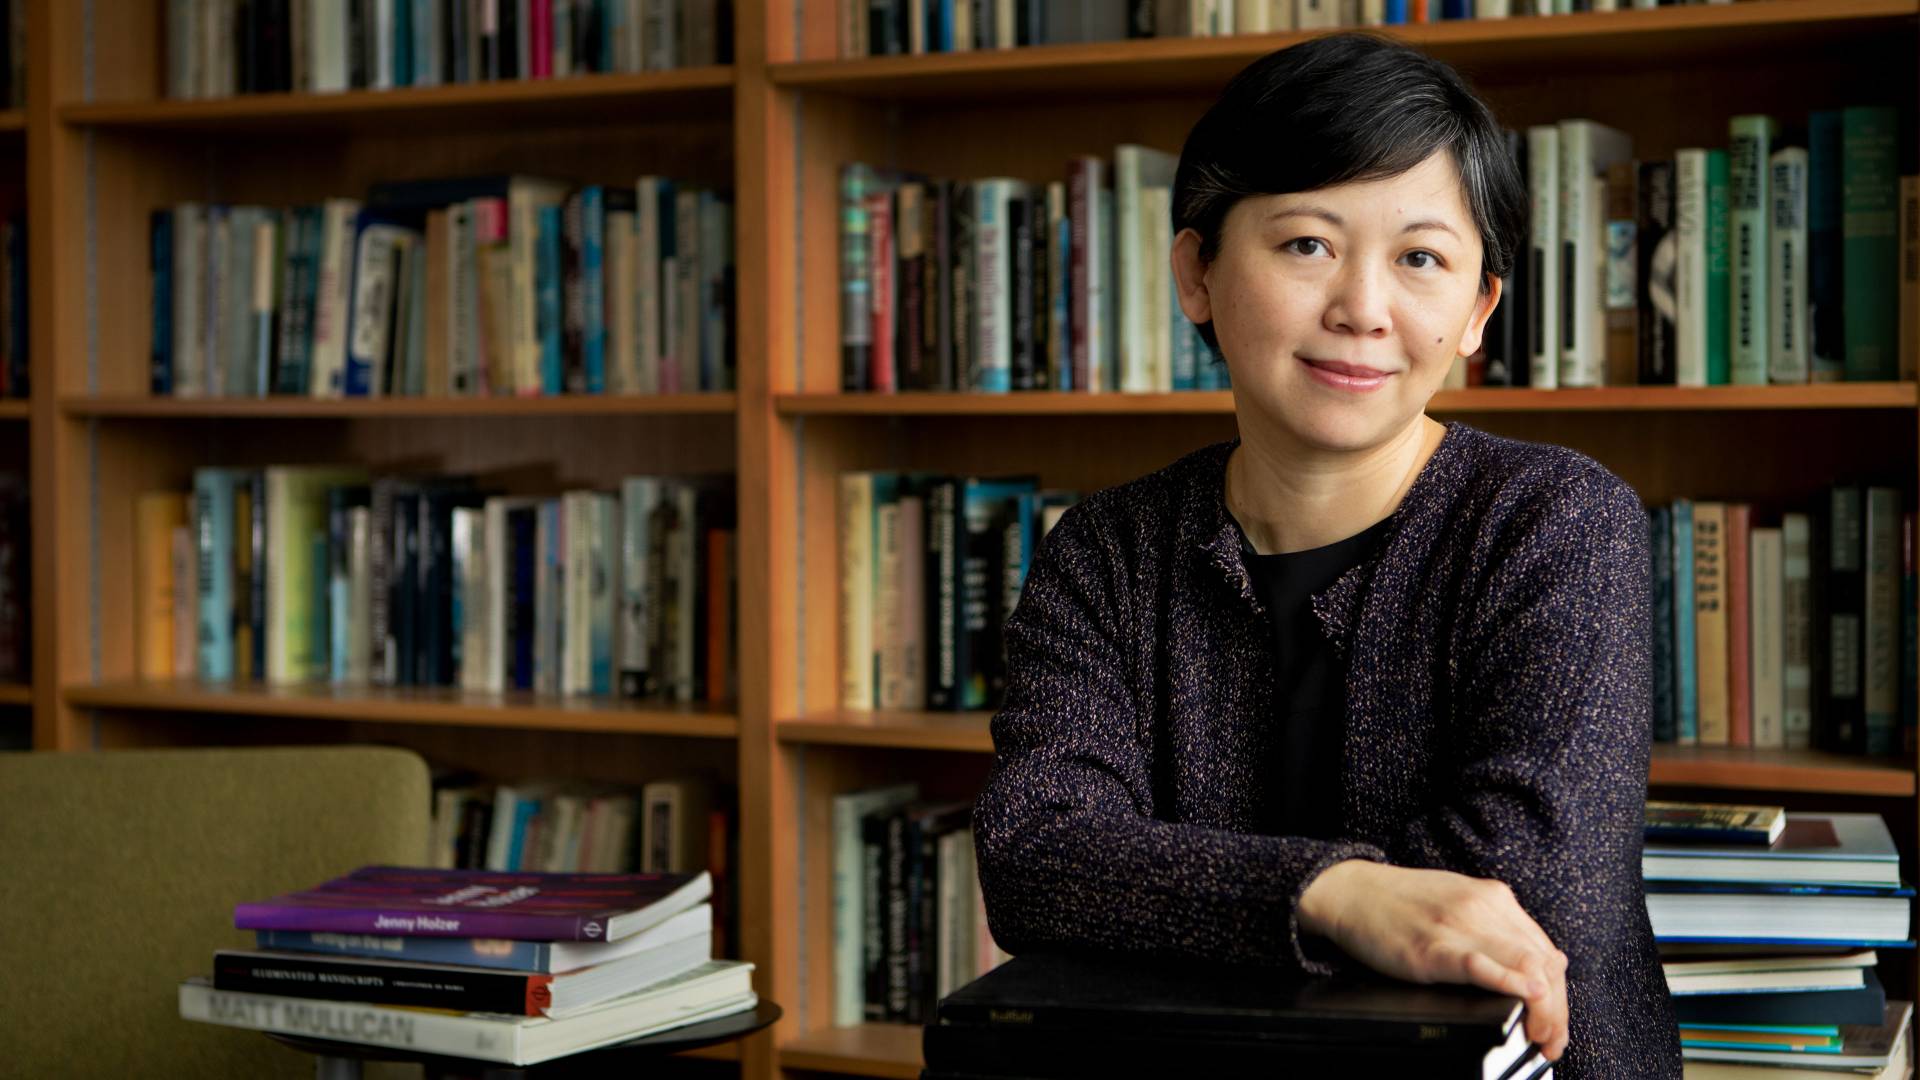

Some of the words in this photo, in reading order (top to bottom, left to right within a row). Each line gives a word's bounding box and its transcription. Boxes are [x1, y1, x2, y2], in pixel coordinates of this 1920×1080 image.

[374, 913, 415, 933] Jenny
[416, 915, 462, 932] Holzer
[251, 967, 316, 982] ILLUMINATED
[318, 971, 384, 987] MANUSCRIPTS
[208, 994, 275, 1028] MATT
[282, 1000, 416, 1045] MULLICAN
